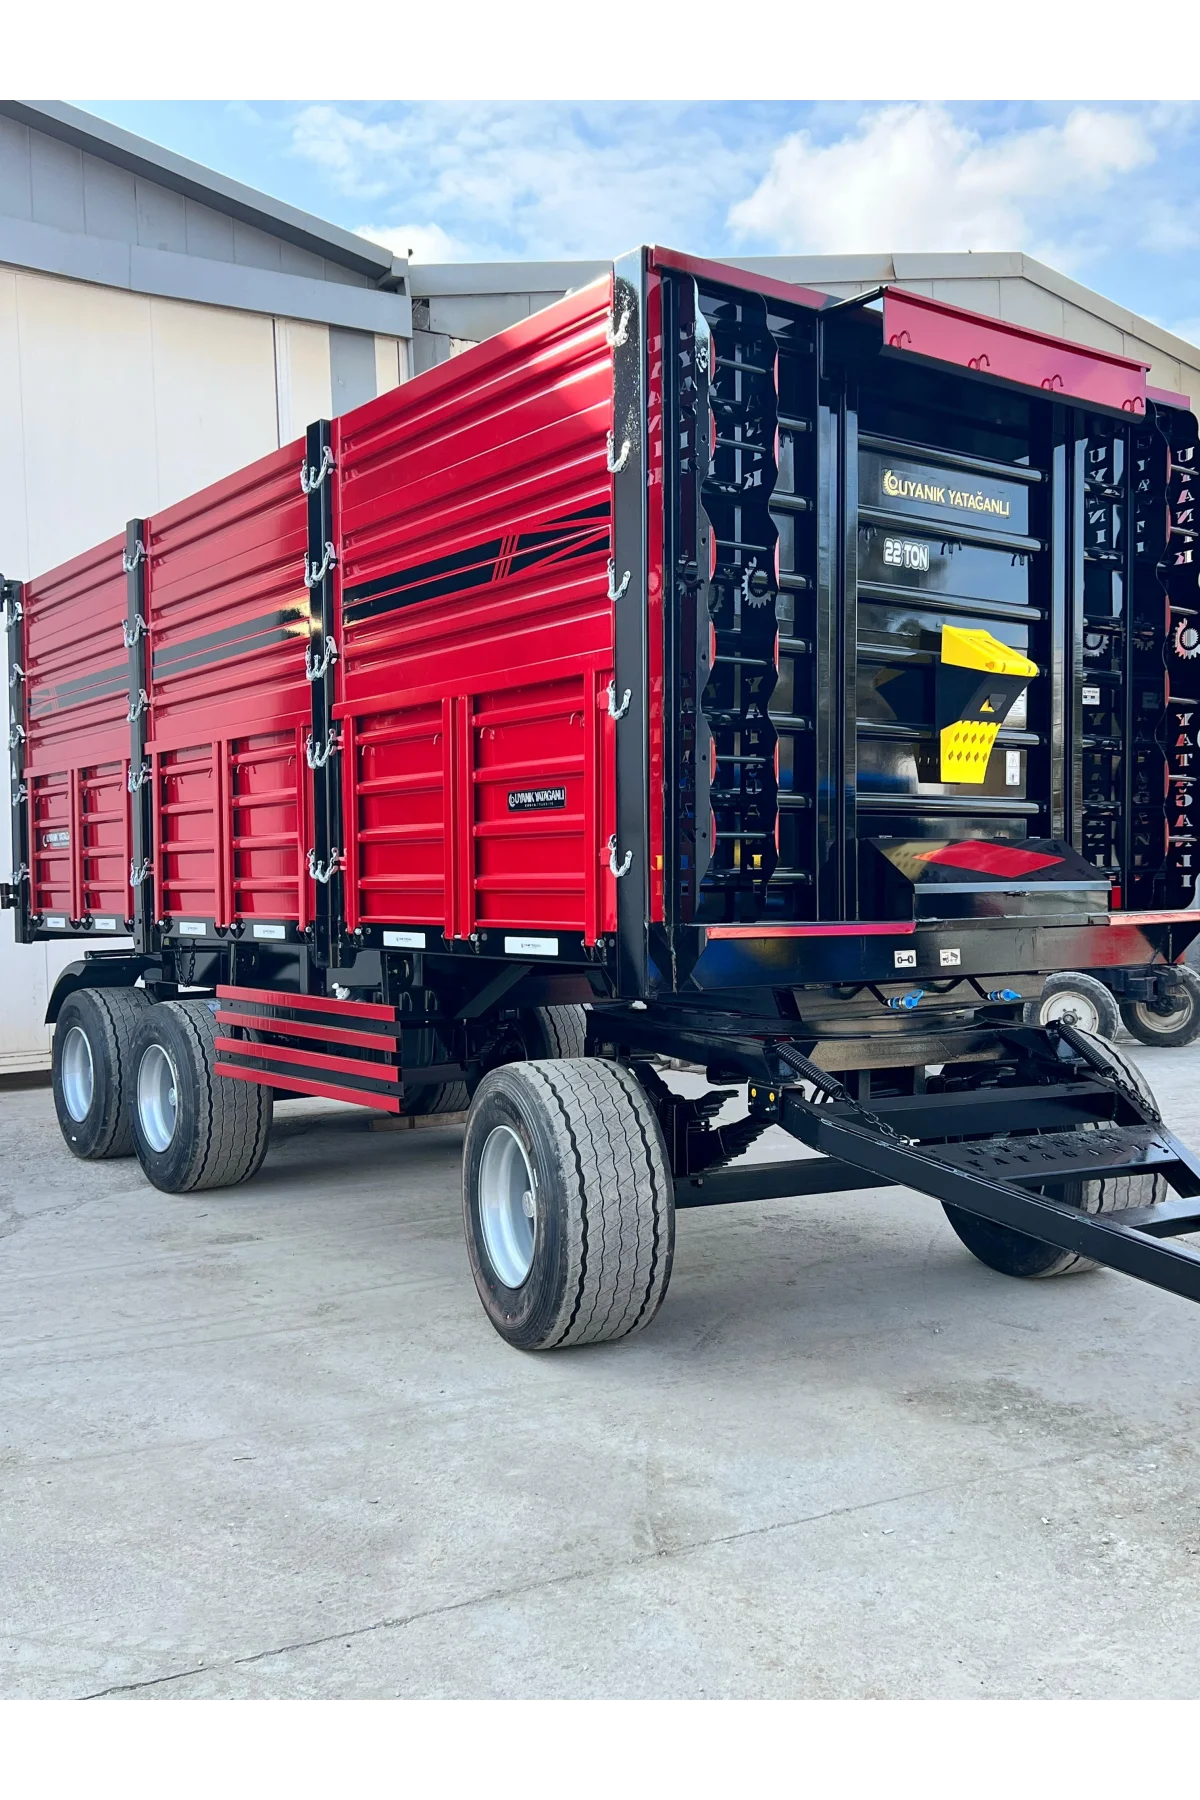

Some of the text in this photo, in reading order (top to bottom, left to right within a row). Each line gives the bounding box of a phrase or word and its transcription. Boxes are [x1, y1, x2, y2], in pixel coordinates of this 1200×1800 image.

[899, 480, 1010, 516] UYANIK YATAĞANLI
[884, 538, 929, 571] 22 TON
